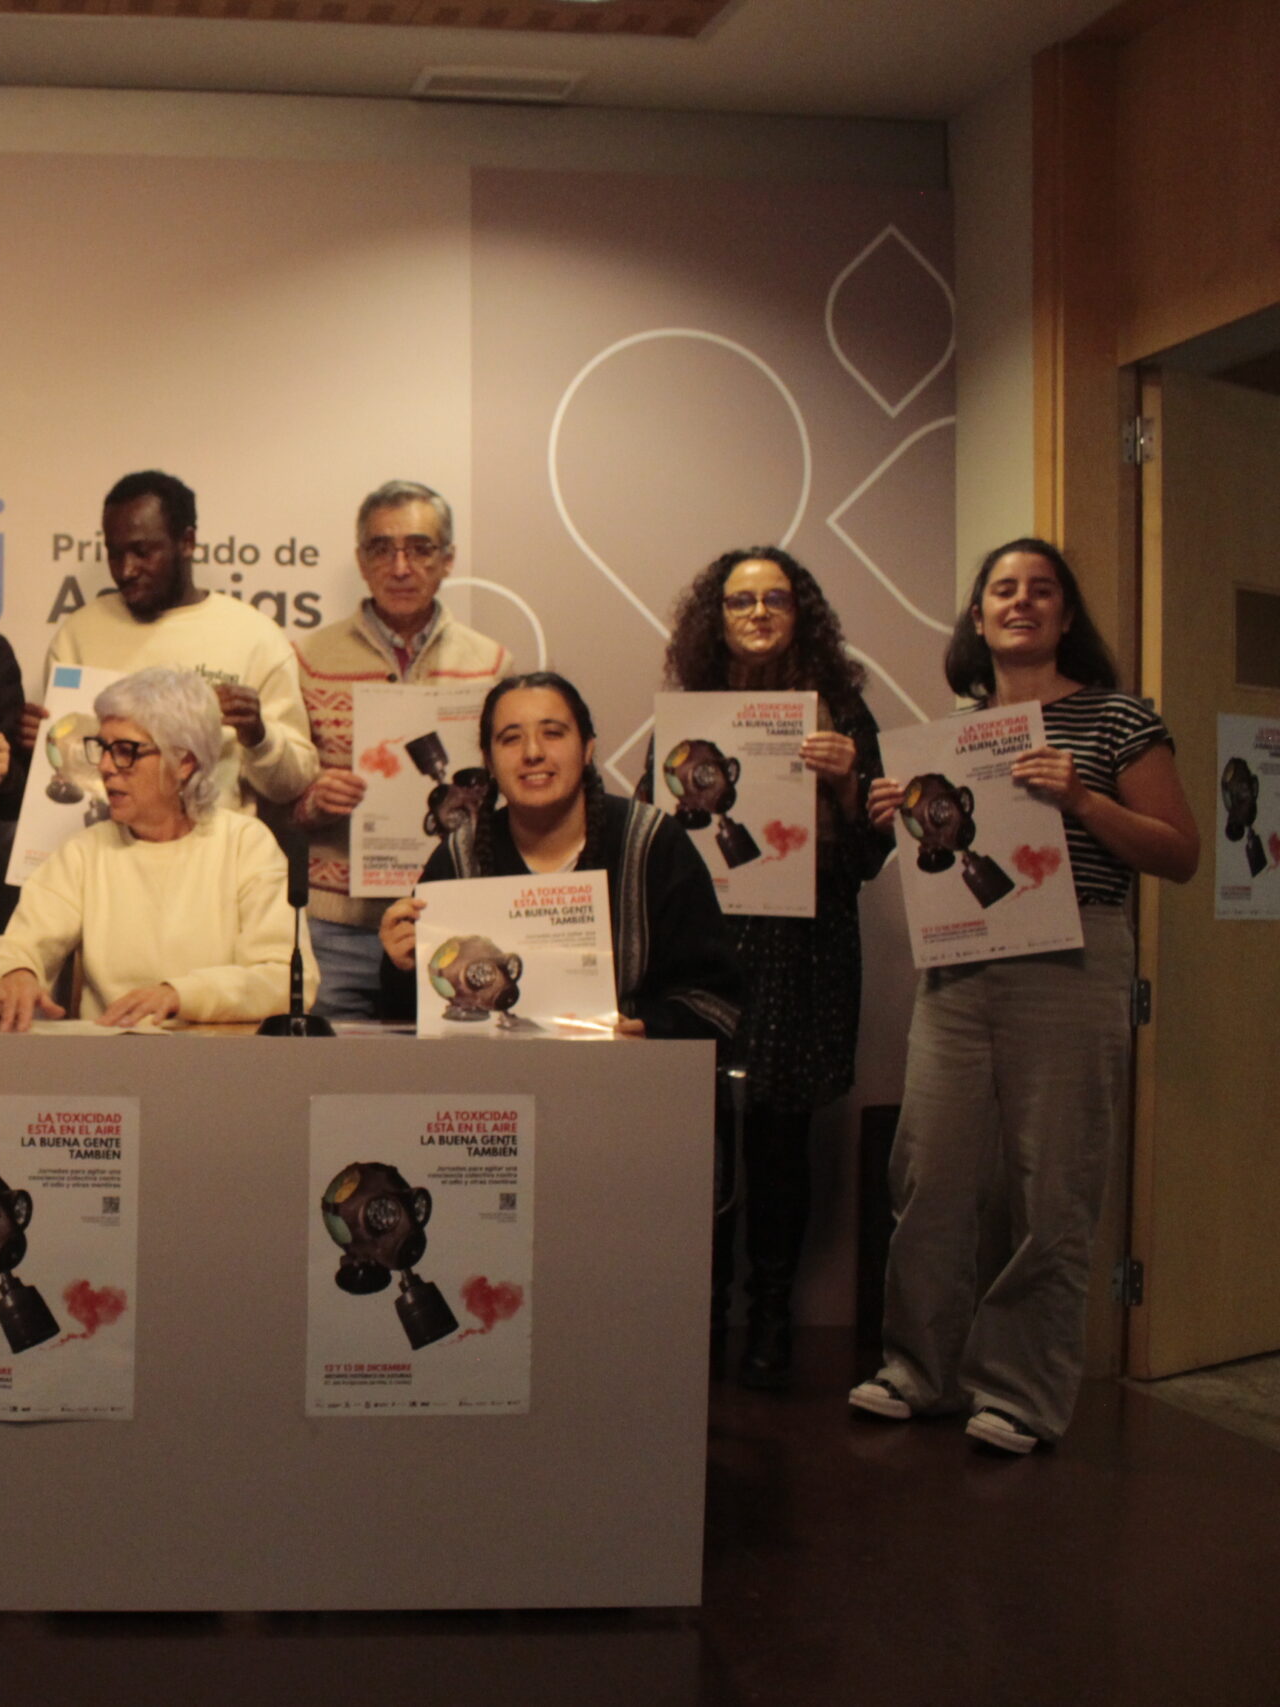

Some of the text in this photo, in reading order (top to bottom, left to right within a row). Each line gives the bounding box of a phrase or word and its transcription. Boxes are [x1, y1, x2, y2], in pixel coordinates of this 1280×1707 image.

[53, 530, 321, 567] Priado de
[732, 720, 803, 728] LA BUENA GENTE
[955, 734, 1031, 755] LA BUENA GENTE
[522, 886, 593, 898] LA TOXICIDAD
[509, 905, 594, 919] LA BUENA GENTE
[550, 914, 595, 926] TAMBIÉN
[38, 1112, 122, 1123] LA TOXICIDAD
[436, 1111, 518, 1121] LA TOXICIDAD
[60, 1125, 75, 1135] EN
[79, 1125, 91, 1135] EL
[95, 1125, 121, 1135] AIRE
[458, 1123, 473, 1133] EN
[476, 1123, 487, 1133] EL
[491, 1122, 518, 1133] AIRE
[21, 1136, 121, 1148] LA BUENA GENTE
[420, 1135, 518, 1146] LA BUENA GENTE
[69, 1148, 121, 1160] TAMBIÉN
[466, 1145, 518, 1157] TAMBIÉN
